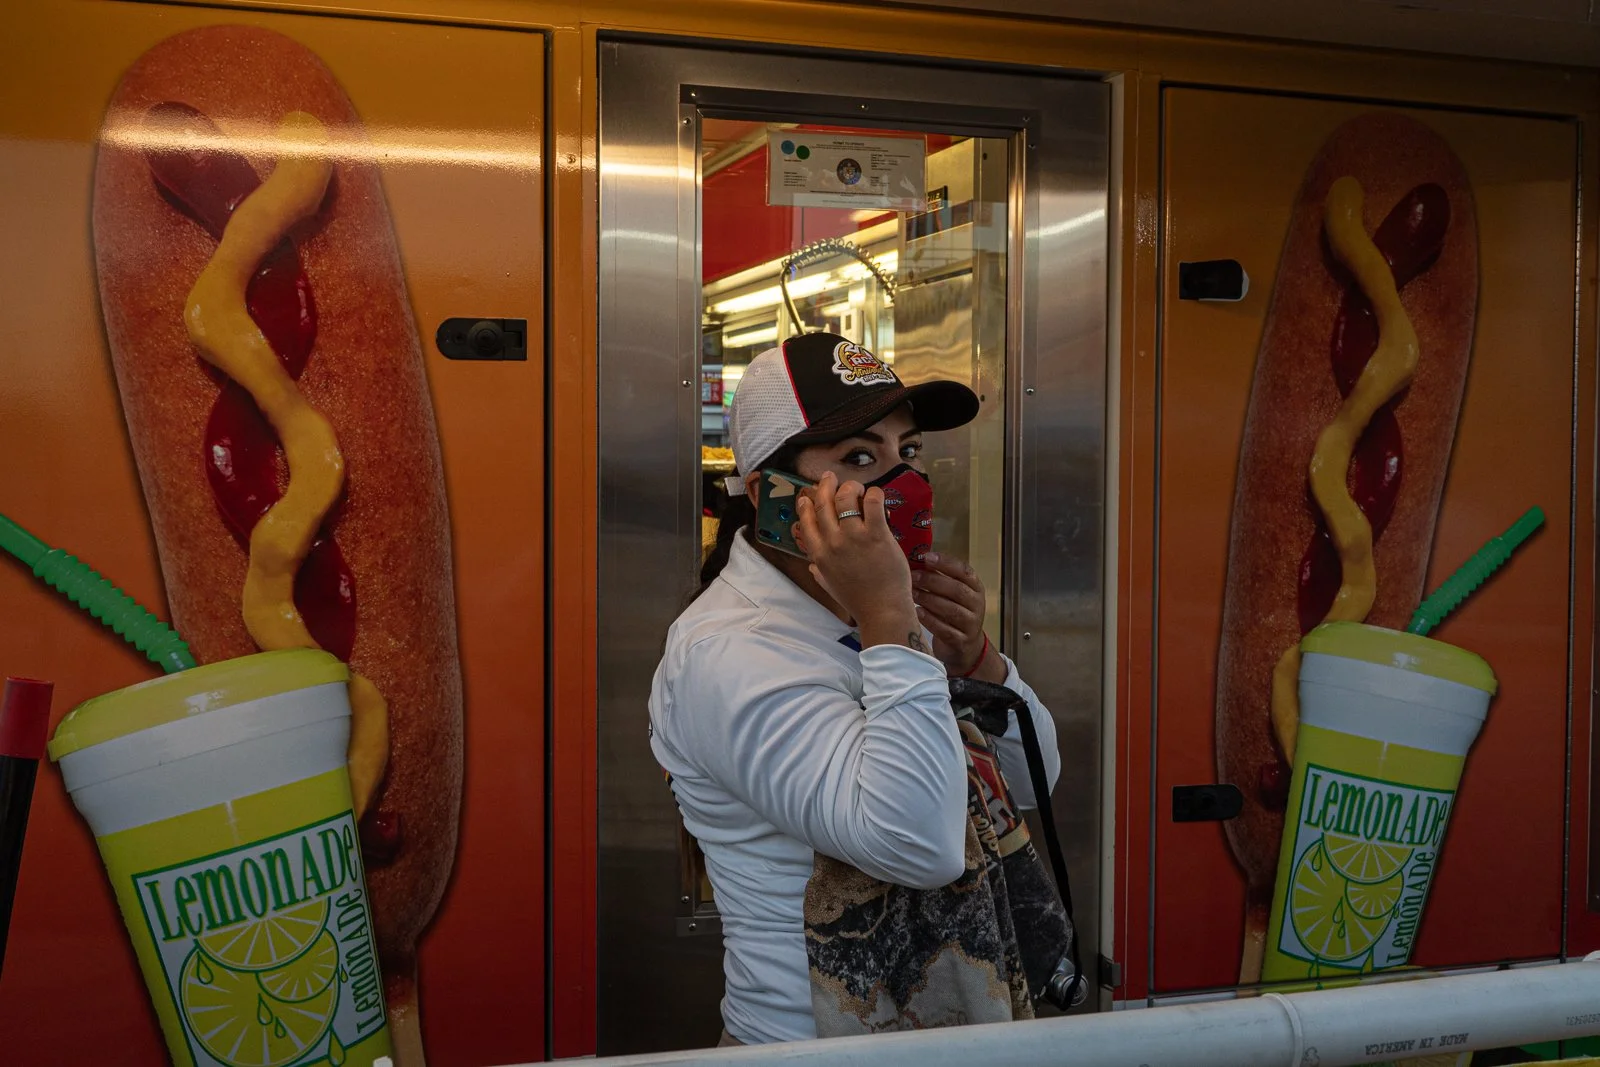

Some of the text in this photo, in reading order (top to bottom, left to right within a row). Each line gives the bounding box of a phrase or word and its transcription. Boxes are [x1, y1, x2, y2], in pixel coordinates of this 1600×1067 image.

[1365, 1032, 1470, 1056] MADE IN AMERICA
